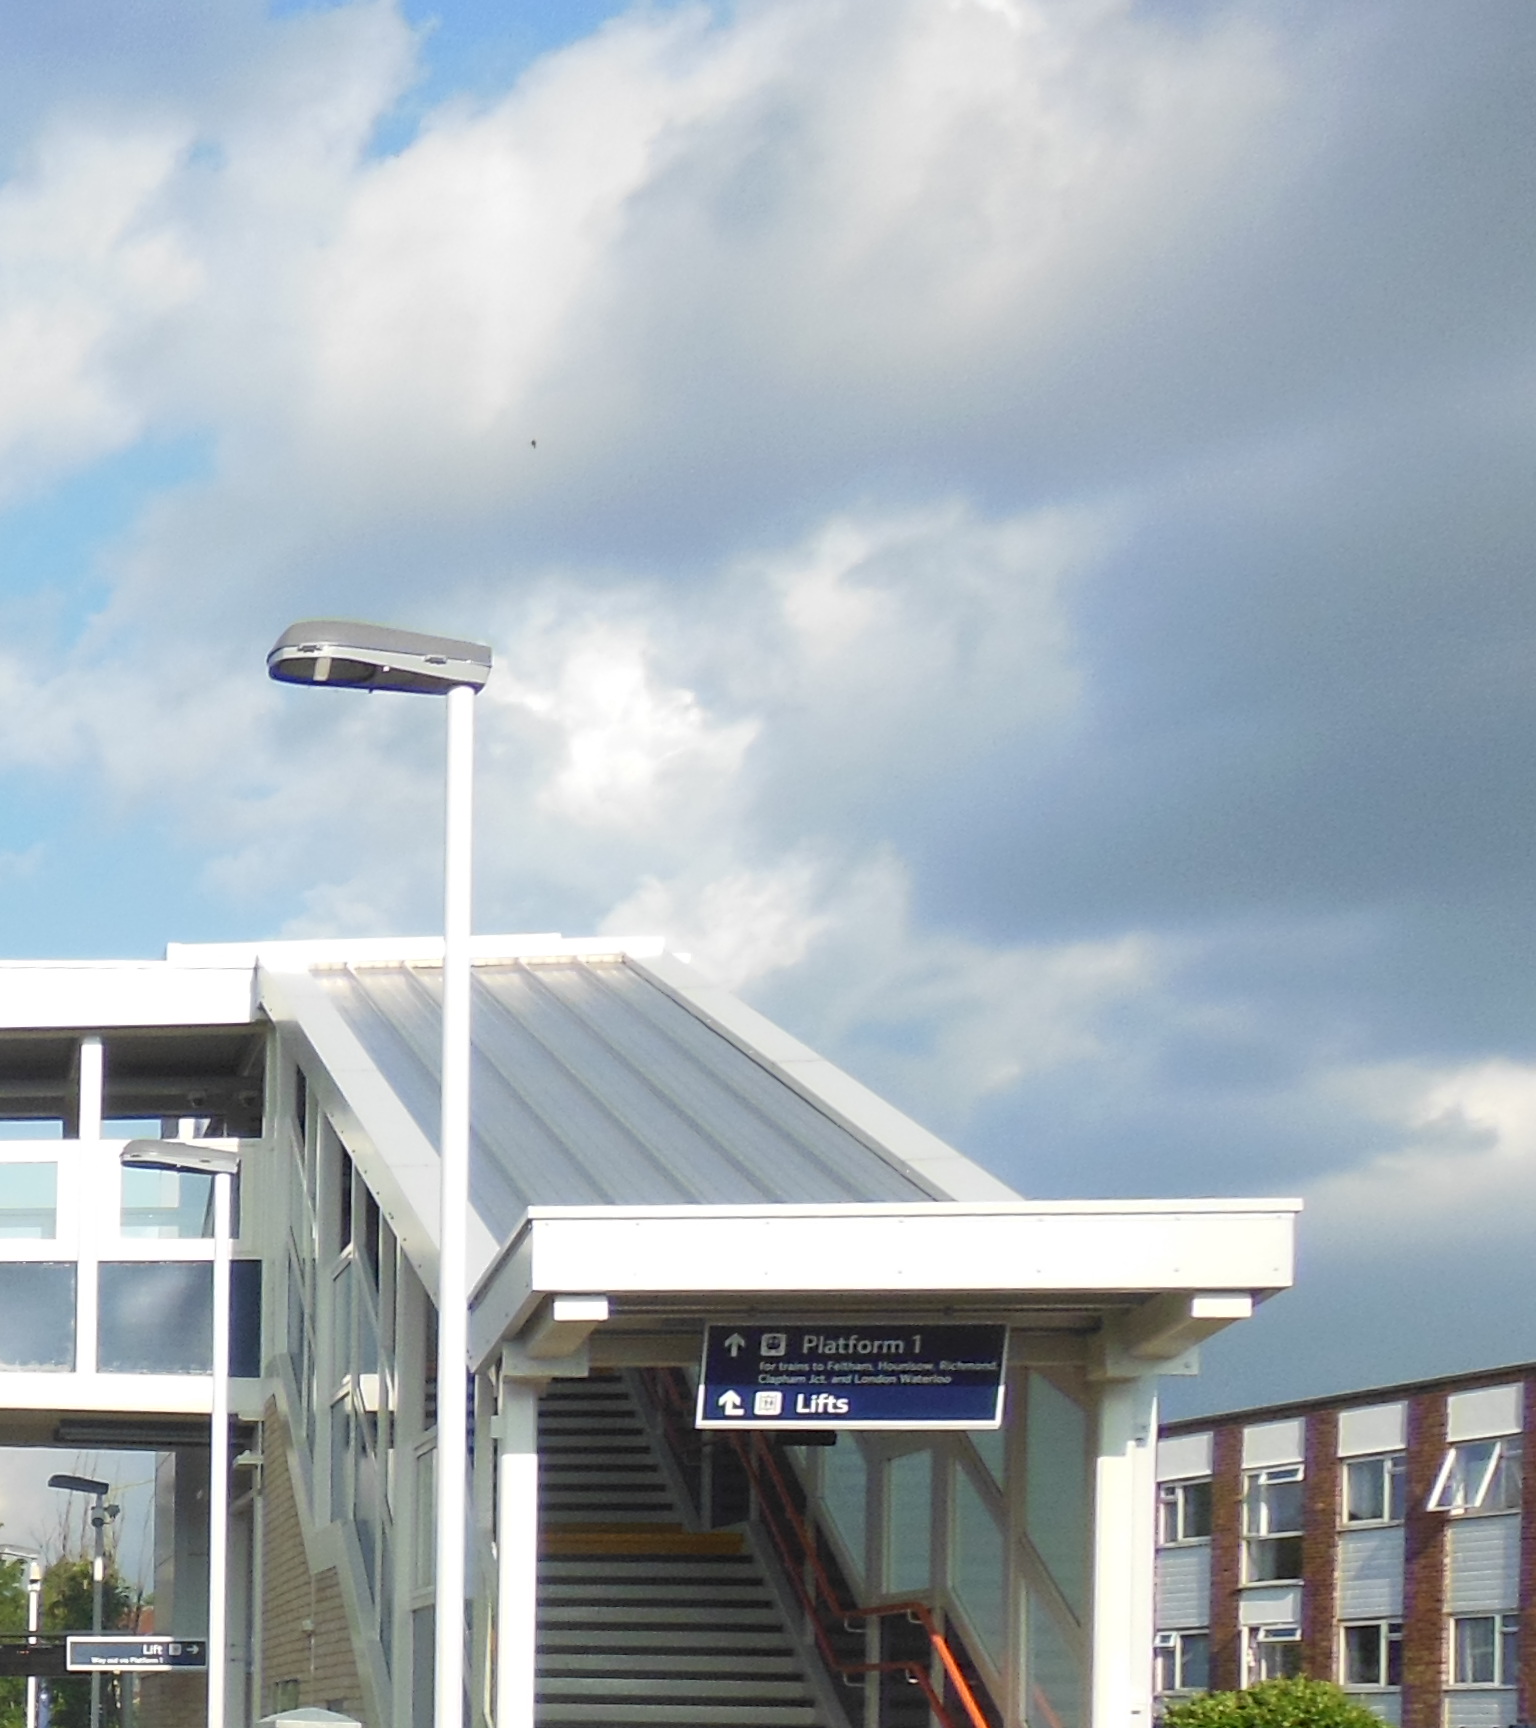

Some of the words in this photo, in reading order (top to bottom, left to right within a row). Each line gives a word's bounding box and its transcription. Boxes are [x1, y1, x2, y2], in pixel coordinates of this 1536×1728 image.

[802, 1334, 904, 1354] Platform
[913, 1335, 922, 1354] 1
[760, 1362, 776, 1371] for
[778, 1362, 810, 1371] trains
[812, 1362, 824, 1371] to
[758, 1374, 806, 1385] Clapham
[831, 1374, 852, 1384] and
[854, 1374, 897, 1384] London
[898, 1374, 952, 1384] Waterloo
[796, 1392, 850, 1415] Lifts
[142, 1644, 163, 1655] Lift
[91, 1656, 107, 1664] Way
[129, 1656, 159, 1664] Platform
